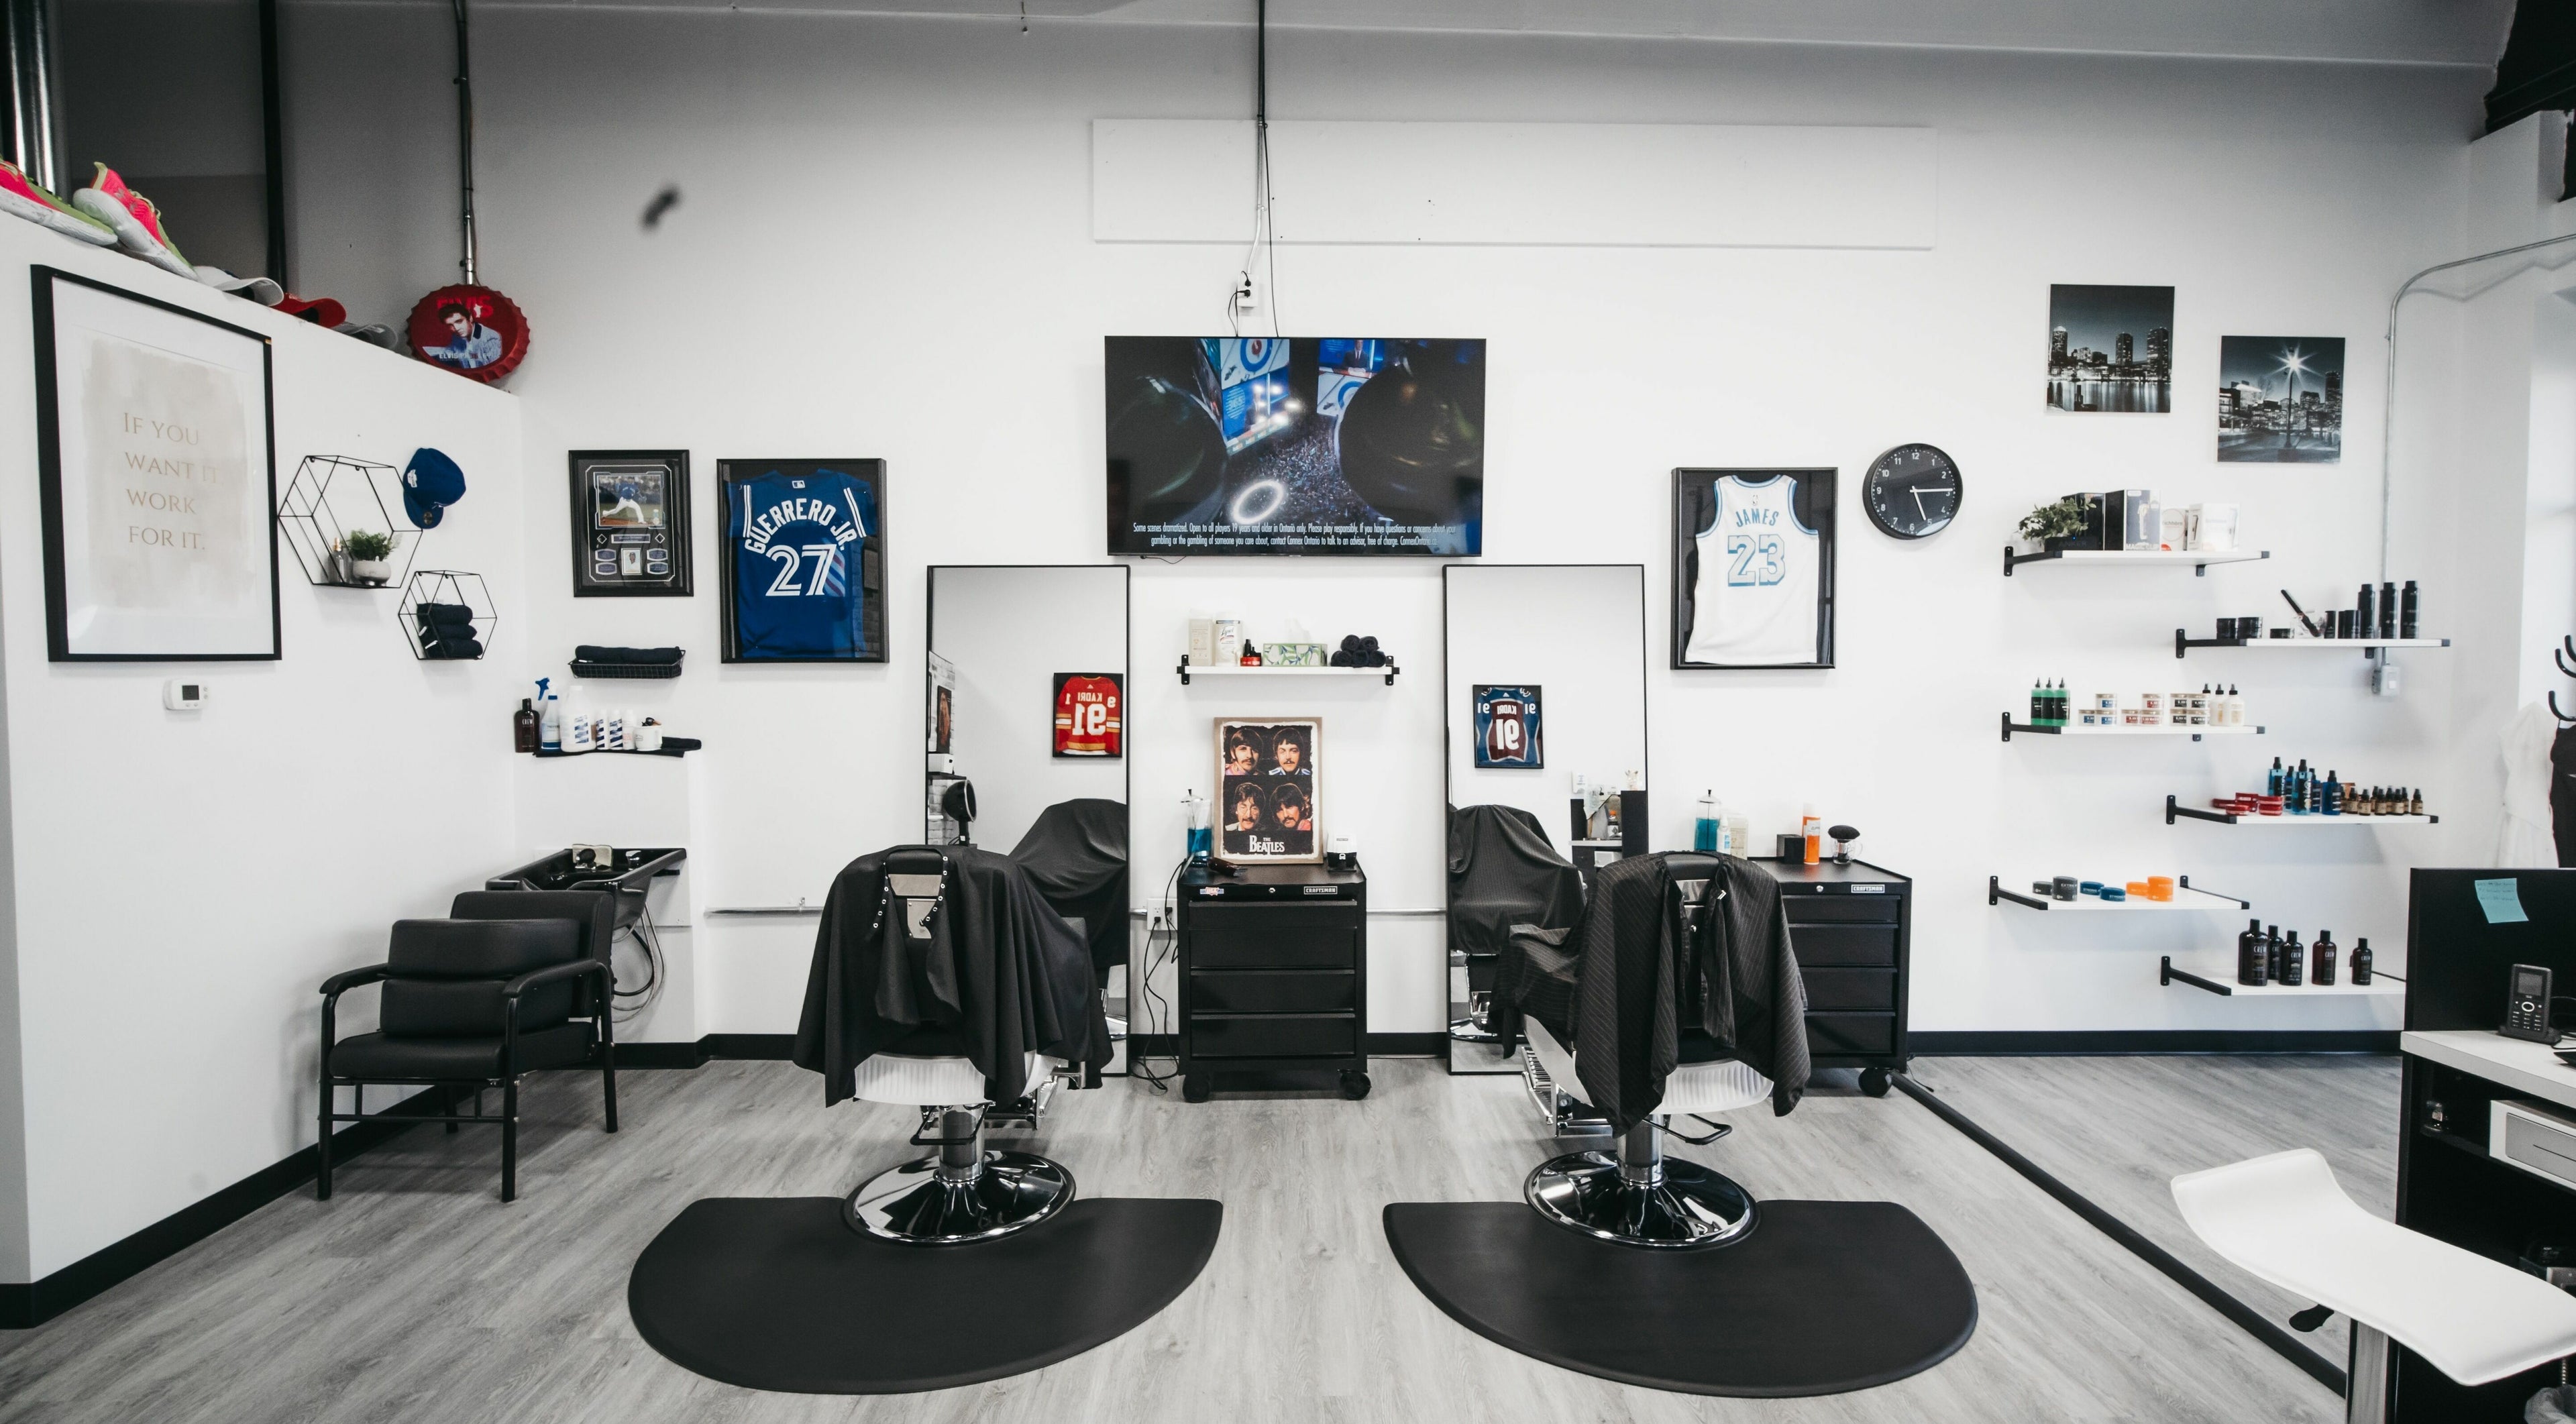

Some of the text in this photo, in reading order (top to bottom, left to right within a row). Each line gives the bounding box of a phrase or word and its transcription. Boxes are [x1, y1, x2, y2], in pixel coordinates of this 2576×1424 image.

[124, 413, 199, 445] IF YOU
[125, 452, 195, 479] WANT
[1941, 471, 1947, 479] 2
[126, 488, 197, 514] WORK
[744, 498, 857, 554] GUERRERO JR.
[1133, 523, 1146, 532] Some
[1163, 522, 1188, 532] dramatized.
[1189, 523, 1201, 534] Open
[1202, 524, 1208, 532] to
[1215, 523, 1230, 534] players
[1232, 523, 1238, 532] 19
[1239, 525, 1250, 534] years
[1252, 523, 1260, 533] and
[1261, 523, 1273, 533] older
[1273, 523, 1278, 533] in
[1279, 523, 1295, 533] Ontario
[1296, 523, 1307, 535] only.
[1308, 523, 1322, 533] Please
[1324, 523, 1333, 535] play
[1334, 523, 1358, 535] responsibly.
[1360, 523, 1364, 533] If
[1364, 526, 1373, 535] you
[1374, 523, 1384, 533] have
[1735, 508, 1779, 527] JAMES
[1893, 517, 1898, 525] 7
[129, 526, 205, 550] FOR IT.
[1151, 535, 1171, 547] gambling
[1187, 535, 1208, 547] gambling
[1208, 535, 1214, 545] of
[1235, 538, 1244, 547] you
[1255, 535, 1269, 546] about,
[1271, 536, 1286, 545] contact
[1287, 535, 1303, 545] Connex
[1303, 535, 1320, 545] Ontario
[1321, 537, 1326, 545] to
[1327, 535, 1336, 545] talk
[1337, 537, 1341, 545] to
[1350, 536, 1366, 546] advisor,
[1367, 535, 1376, 545] free
[1377, 535, 1383, 545] of
[1383, 535, 1399, 547] charge.
[765, 544, 837, 596] 27
[1727, 534, 1786, 587] 23
[1249, 834, 1285, 855] BEATLES
[2253, 945, 2266, 953] CREW
